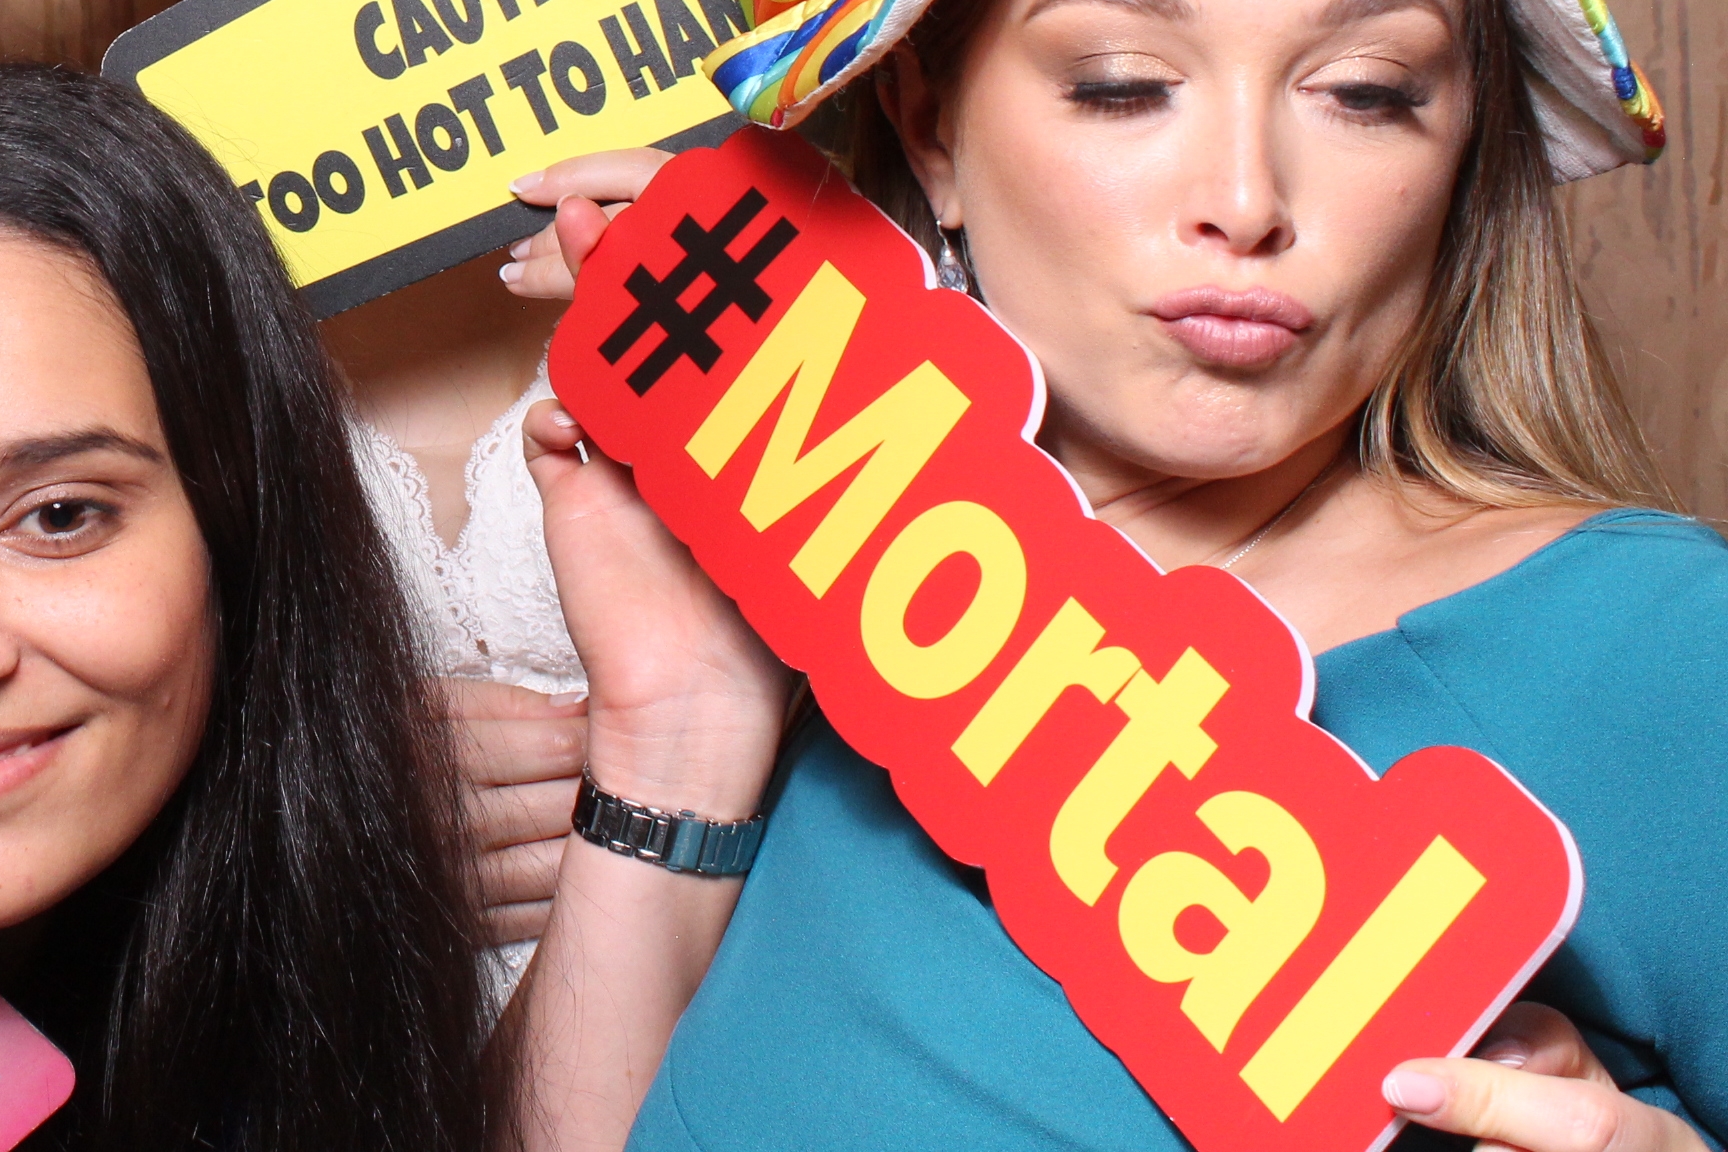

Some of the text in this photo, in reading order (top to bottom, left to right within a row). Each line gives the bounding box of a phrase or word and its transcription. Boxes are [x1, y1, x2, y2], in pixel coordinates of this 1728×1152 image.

[361, 65, 506, 199] HOT
[504, 40, 608, 135] TO
[597, 186, 1487, 1123] #Mortal
